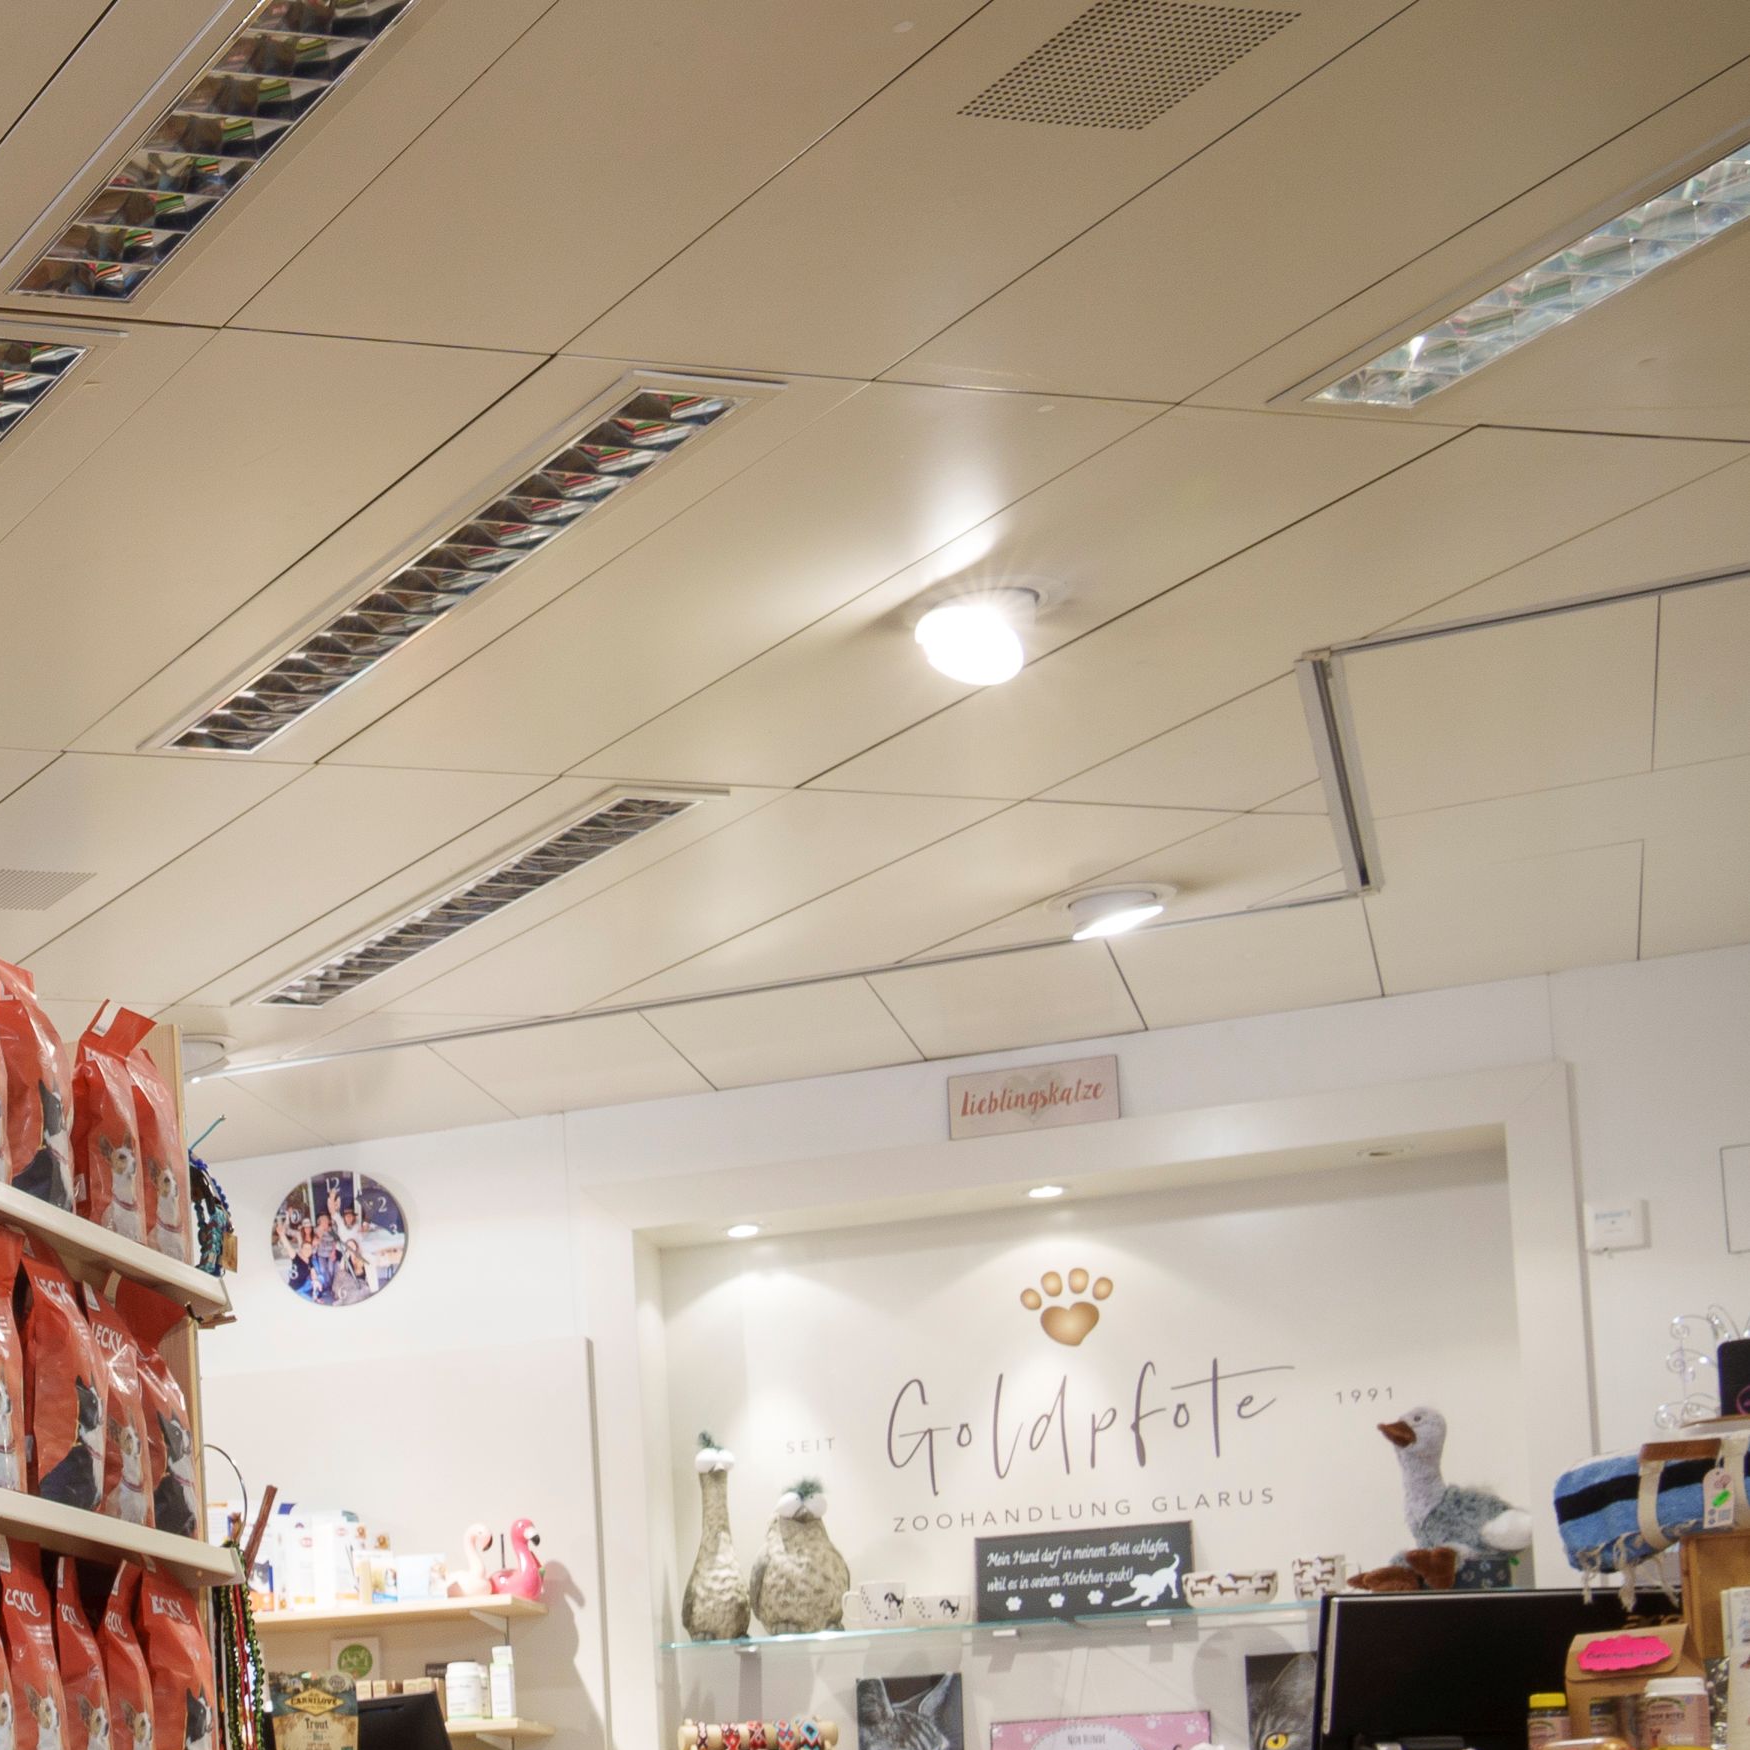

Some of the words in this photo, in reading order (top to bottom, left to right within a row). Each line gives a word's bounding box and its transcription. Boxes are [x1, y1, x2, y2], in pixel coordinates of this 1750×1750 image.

[1335, 1386, 1396, 1405] 1991
[887, 1357, 1295, 1497] Goldpfote
[786, 1436, 837, 1454] SEIT
[893, 1498, 1133, 1534] ZOOHANDLUNG
[1151, 1487, 1275, 1513] GLARUS
[987, 1552, 1010, 1567] Mein
[1013, 1549, 1039, 1565] Hund
[1041, 1549, 1061, 1569] darf
[1062, 1546, 1071, 1560] in
[1073, 1545, 1106, 1560] meinem
[1109, 1542, 1129, 1556] Bett
